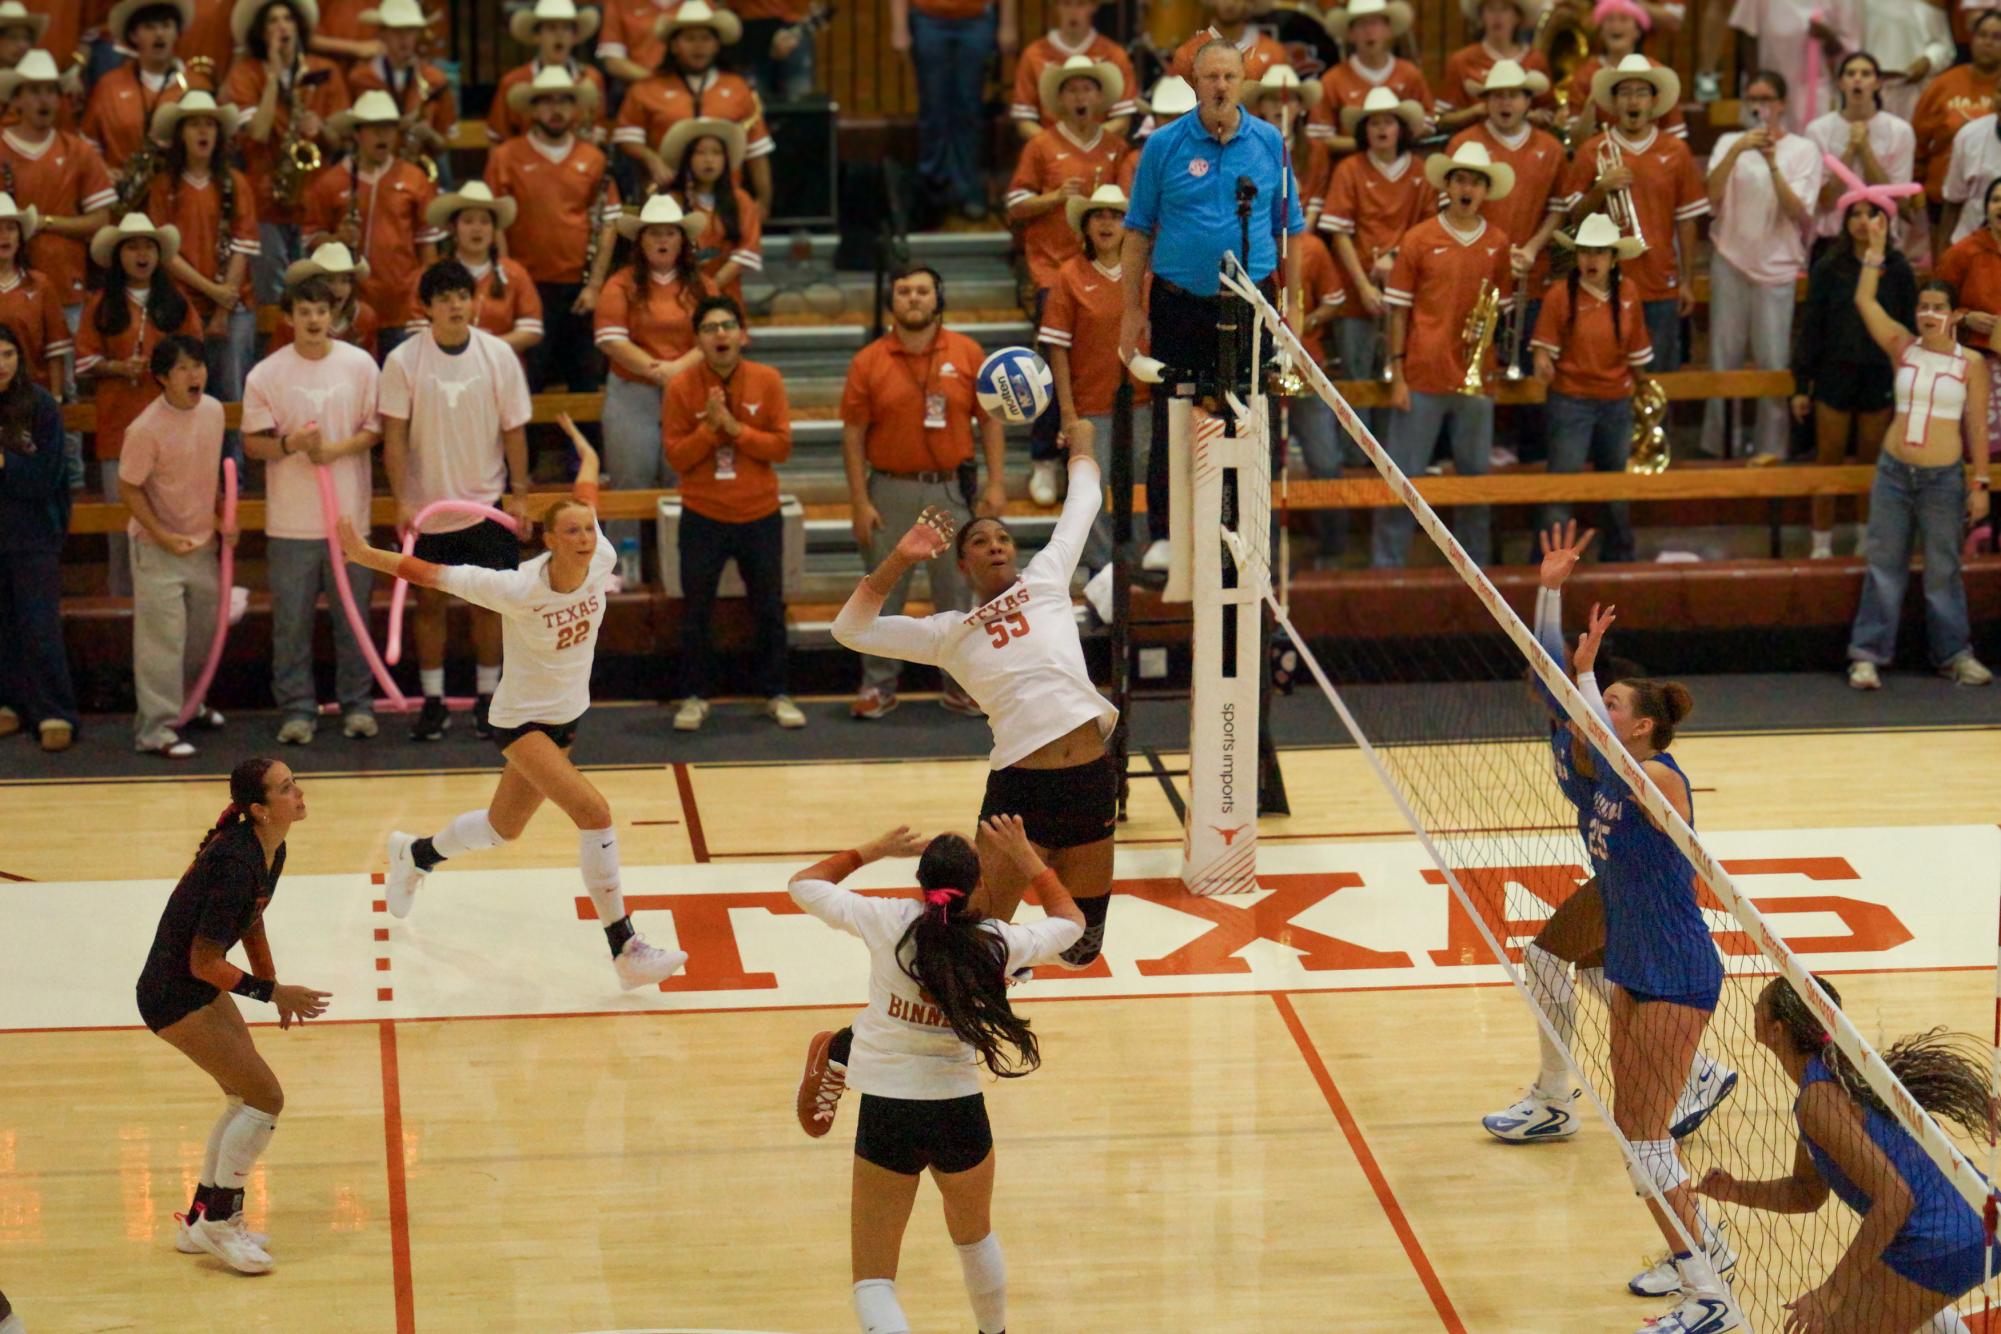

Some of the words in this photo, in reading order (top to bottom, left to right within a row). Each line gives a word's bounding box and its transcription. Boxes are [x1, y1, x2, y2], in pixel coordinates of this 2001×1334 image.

[998, 375, 1021, 416] molten
[542, 596, 600, 629] TEXAS
[963, 588, 1031, 627] TEXAS
[556, 619, 591, 651] 22
[984, 611, 1032, 650] 55
[1221, 703, 1235, 752] sports
[1219, 754, 1235, 814] imports
